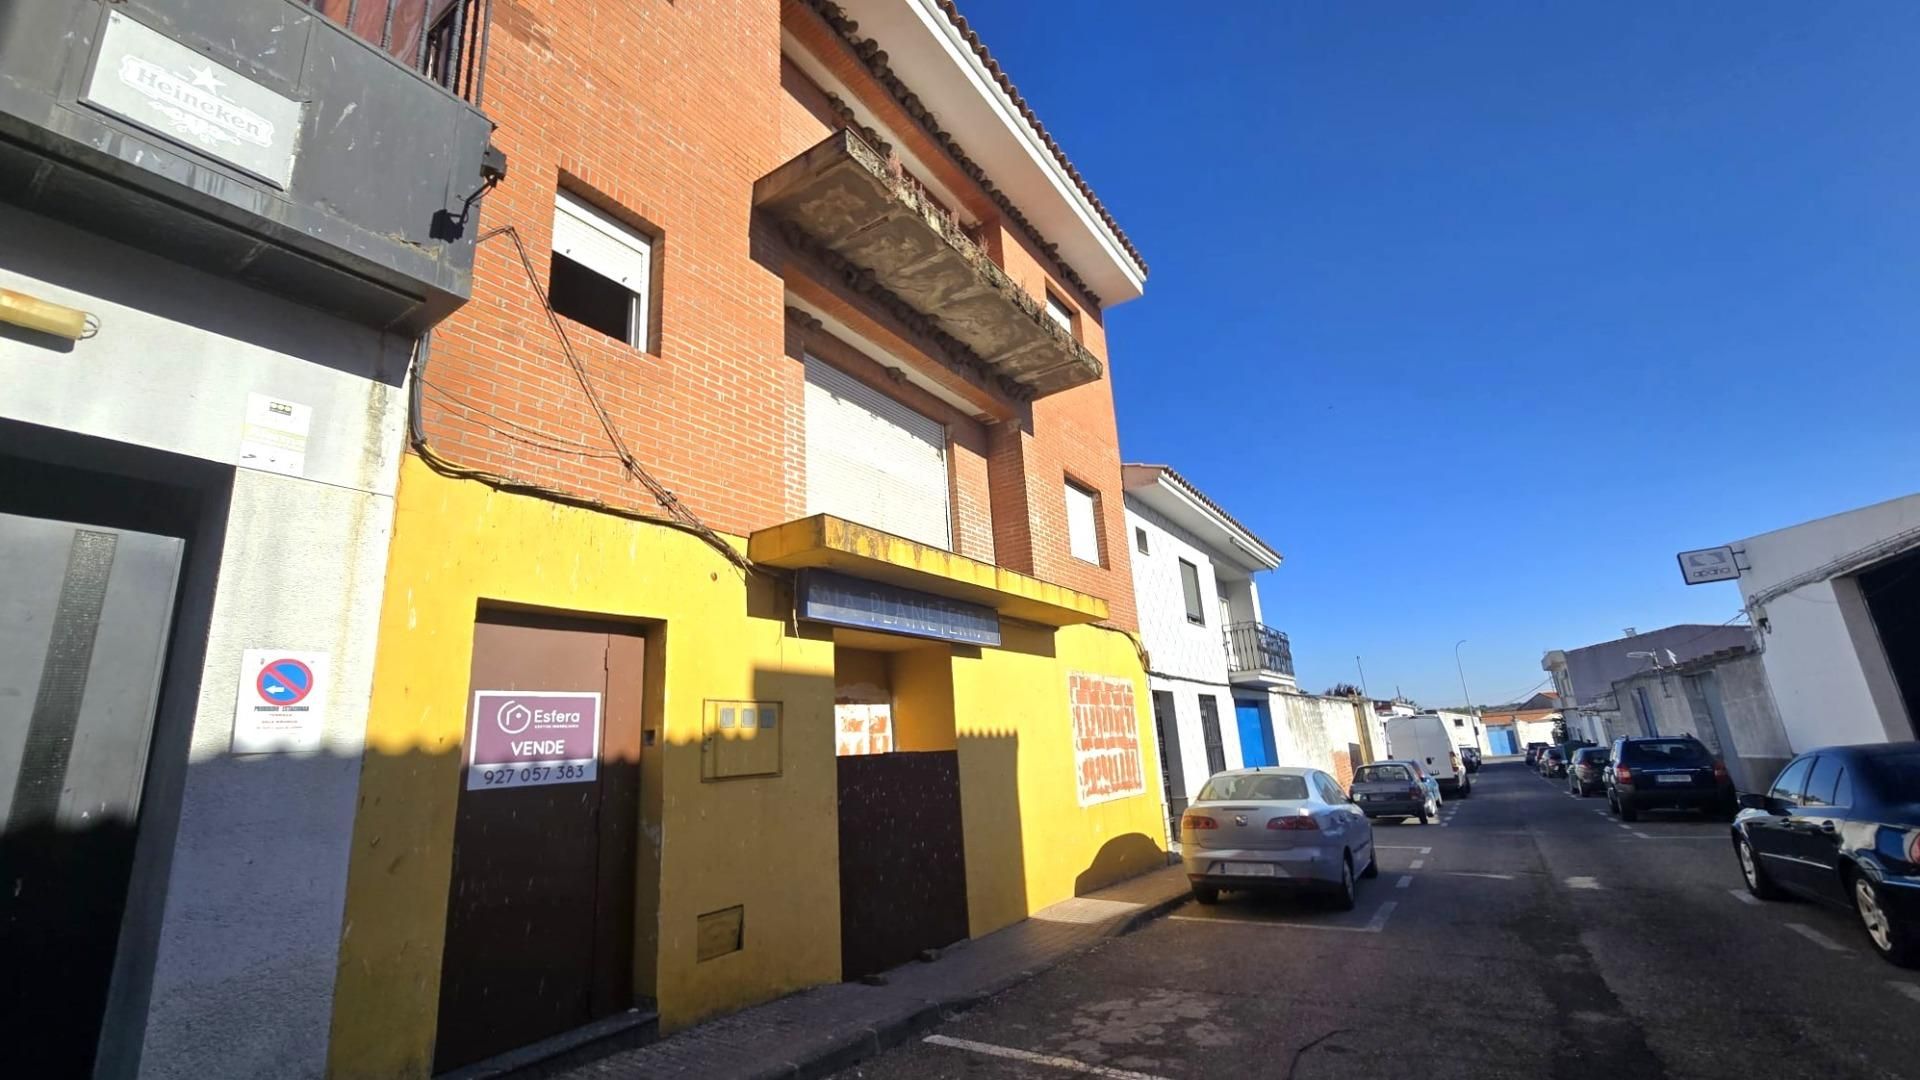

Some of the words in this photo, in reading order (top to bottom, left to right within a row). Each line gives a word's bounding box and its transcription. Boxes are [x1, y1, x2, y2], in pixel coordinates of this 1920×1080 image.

[136, 67, 261, 137] Heineken
[534, 709, 580, 723] Esfera
[511, 739, 565, 756] VENDE
[483, 769, 515, 785] 927
[520, 767, 551, 782] 057
[556, 765, 584, 780] 383
